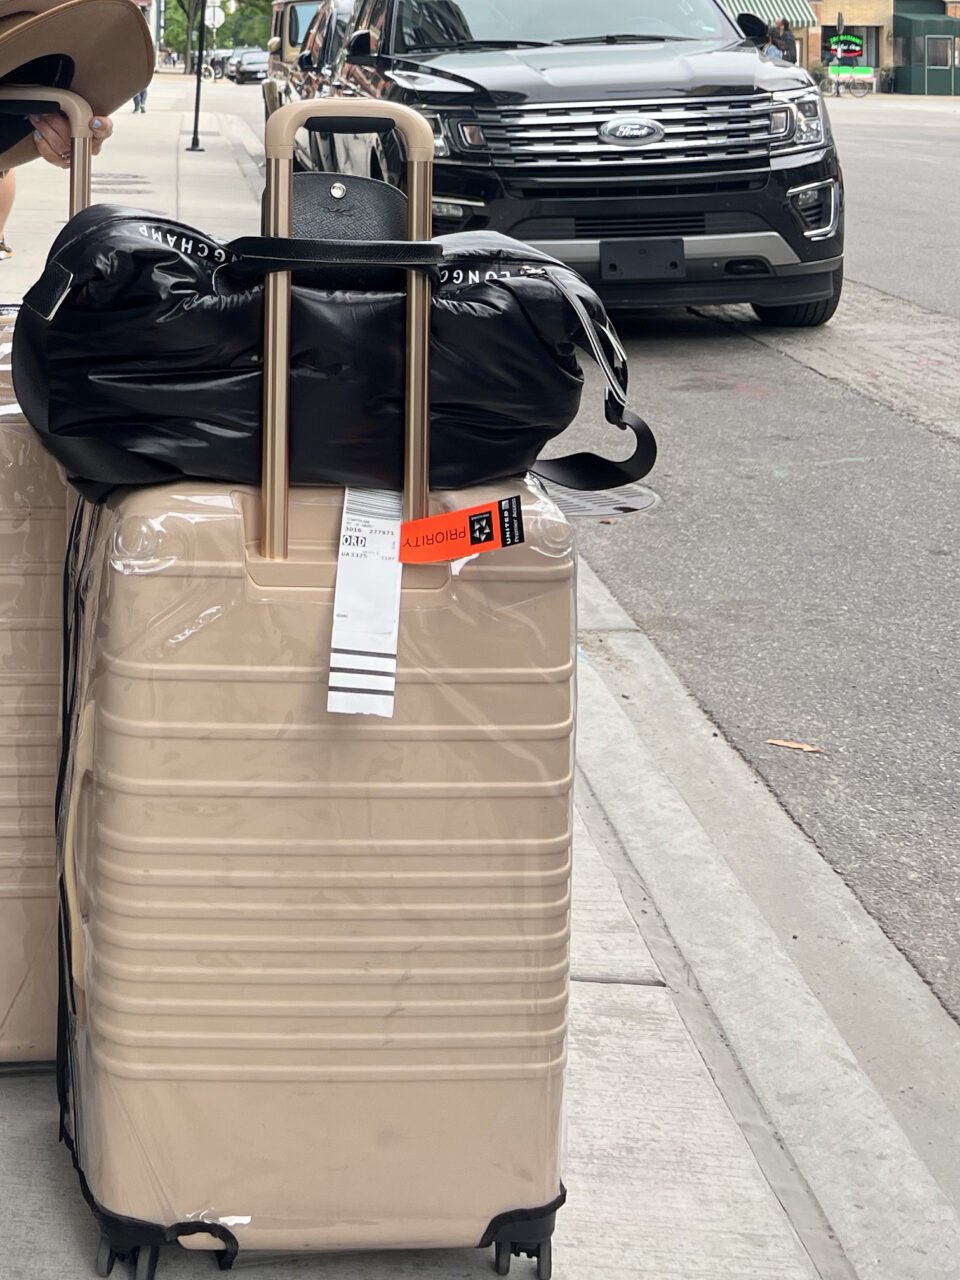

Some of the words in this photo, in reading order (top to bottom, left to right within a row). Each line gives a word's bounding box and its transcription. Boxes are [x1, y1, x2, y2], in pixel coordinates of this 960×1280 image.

[402, 526, 467, 548] PRIORITY
[503, 510, 512, 545] UNITED
[342, 535, 367, 548] ORD
